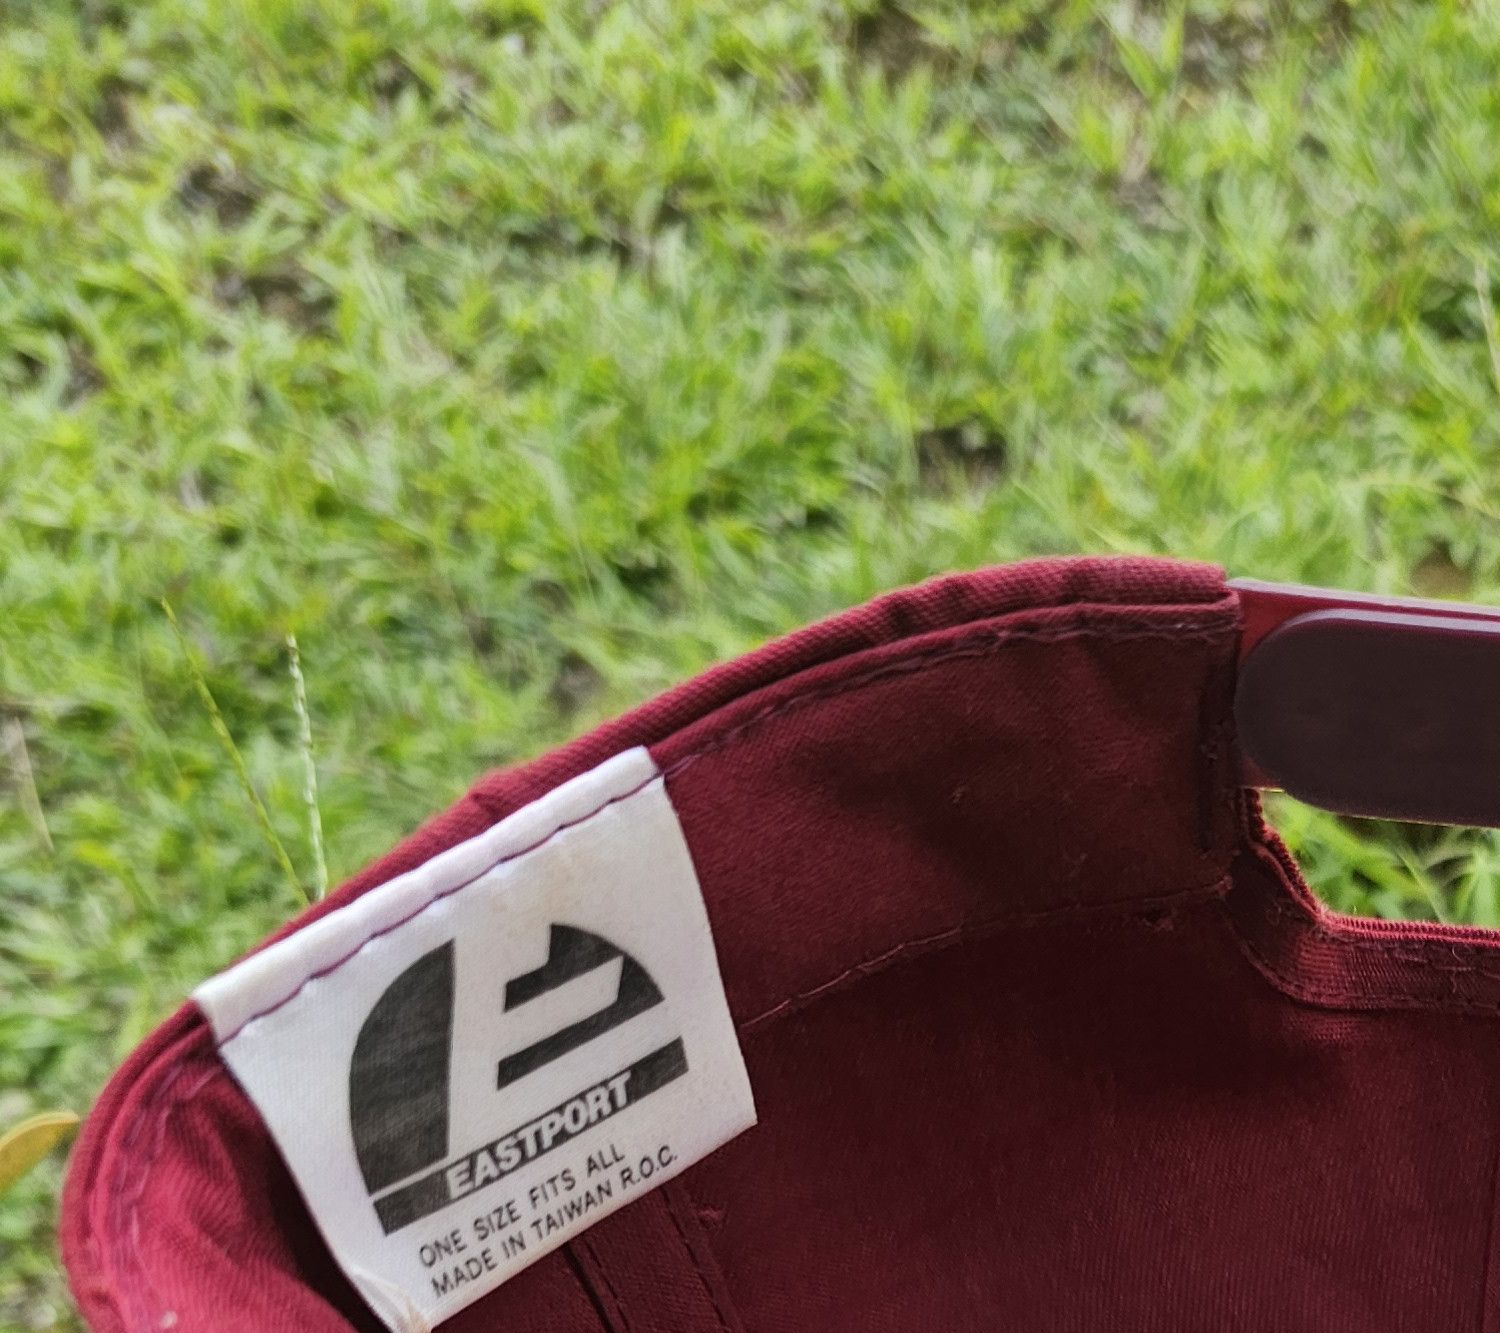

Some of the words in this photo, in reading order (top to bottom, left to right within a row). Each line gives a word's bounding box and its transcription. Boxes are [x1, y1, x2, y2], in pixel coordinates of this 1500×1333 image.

[447, 1070, 631, 1200] EASTPORT
[419, 1229, 467, 1268] ONE
[473, 1200, 521, 1241] SIZE
[529, 1168, 577, 1209] FITS
[587, 1144, 625, 1178] ALL
[431, 1248, 498, 1298] MADE
[503, 1231, 526, 1258] IN
[531, 1180, 613, 1240] TAIWAN
[620, 1145, 678, 1191] R.O.C.
